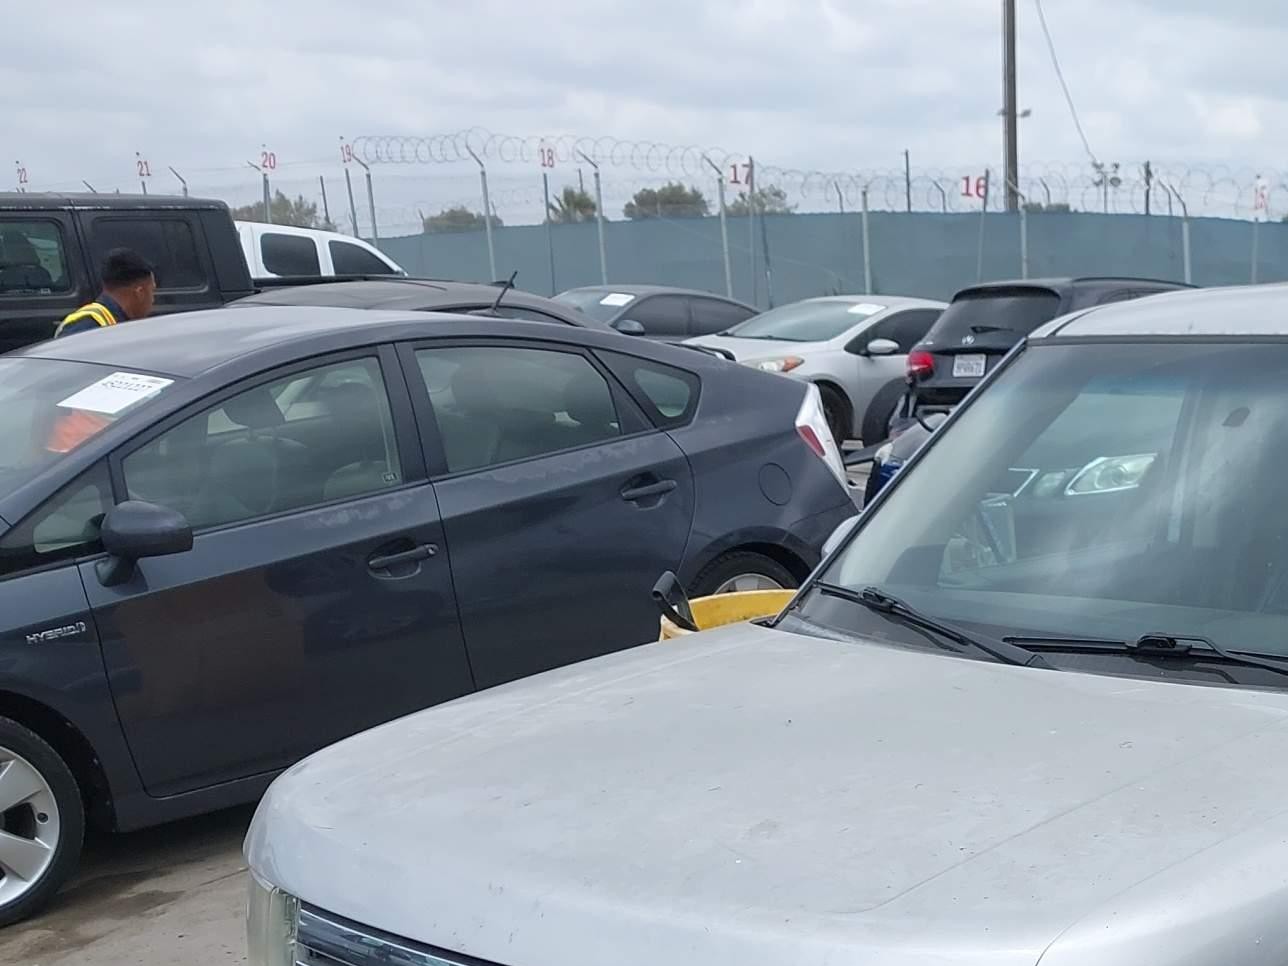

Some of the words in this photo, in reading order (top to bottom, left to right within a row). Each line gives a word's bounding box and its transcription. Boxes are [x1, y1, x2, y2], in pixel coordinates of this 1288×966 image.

[261, 151, 276, 169] 20
[340, 144, 353, 163] 19
[540, 147, 554, 168] 18
[17, 167, 28, 184] 22
[137, 160, 151, 176] 21
[729, 163, 753, 185] 17
